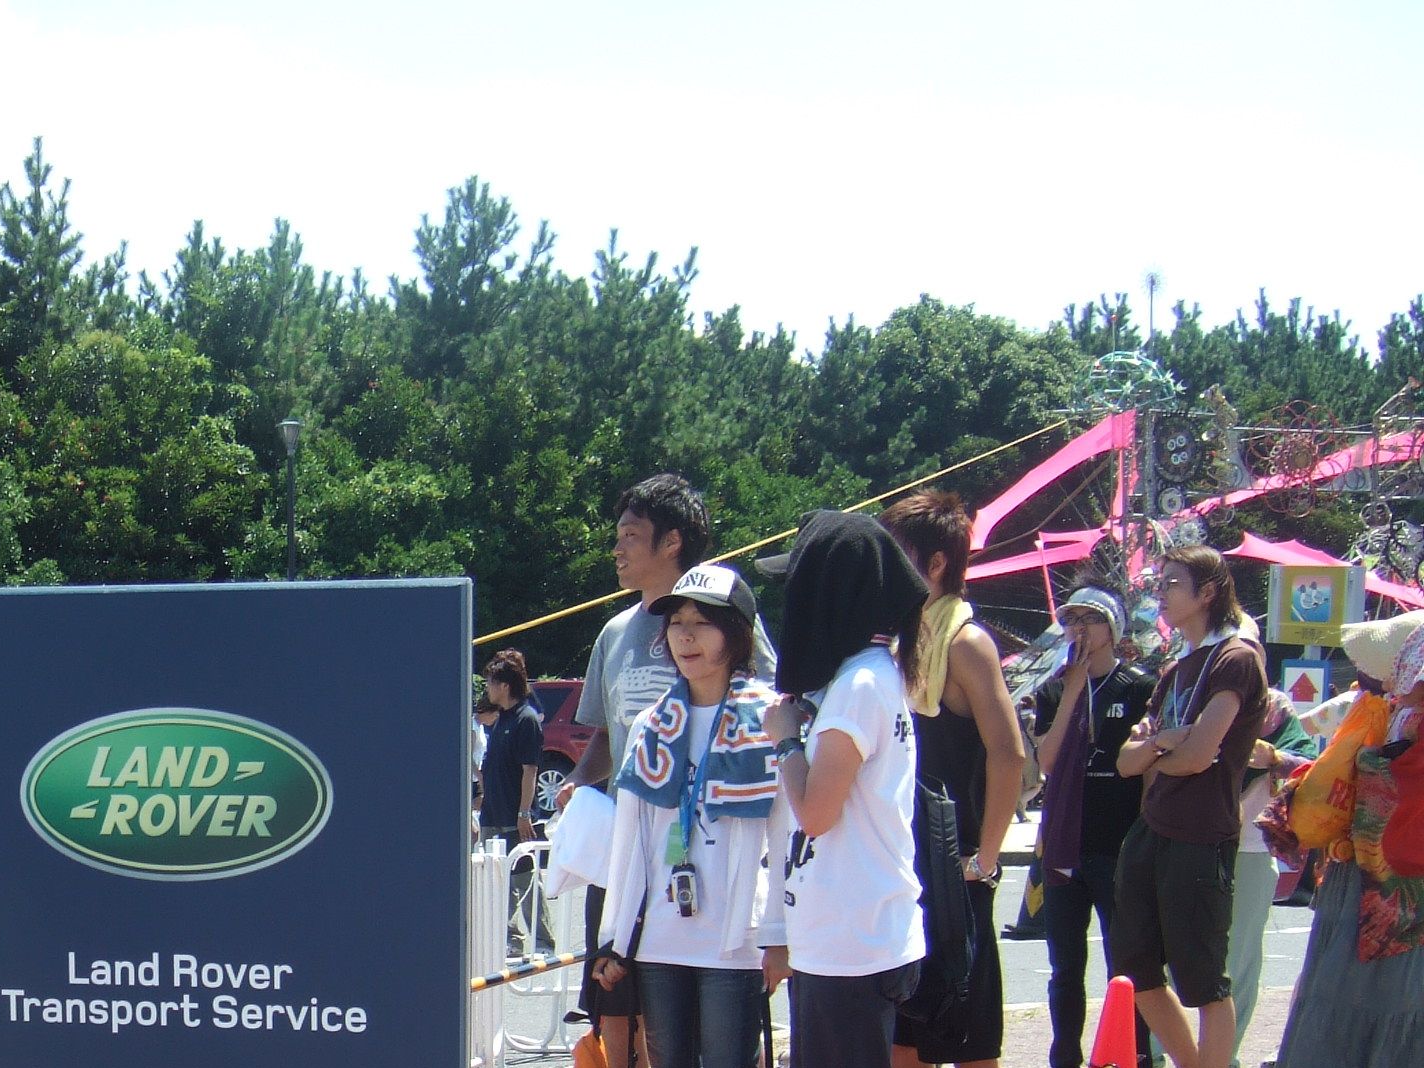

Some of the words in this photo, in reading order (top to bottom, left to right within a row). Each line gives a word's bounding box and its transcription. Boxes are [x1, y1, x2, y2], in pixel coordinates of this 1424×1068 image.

[86, 746, 230, 788] LAND
[99, 794, 278, 837] ROVER
[68, 951, 160, 987] Land
[173, 953, 293, 990] Rover
[1, 988, 201, 1033] Transport
[212, 994, 368, 1034] Service
